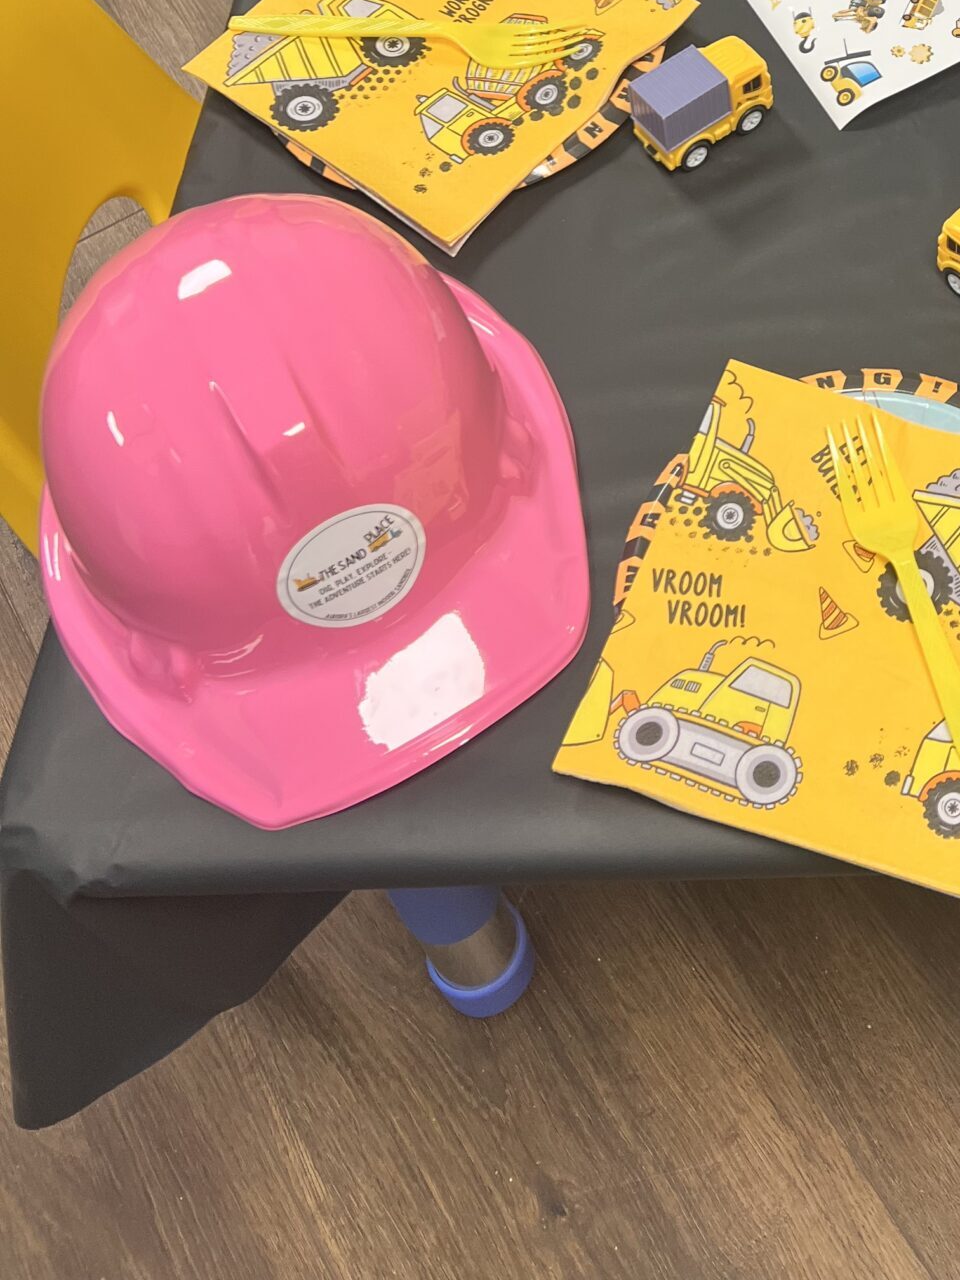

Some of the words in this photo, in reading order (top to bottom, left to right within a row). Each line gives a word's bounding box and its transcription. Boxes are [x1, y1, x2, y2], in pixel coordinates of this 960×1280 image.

[319, 565, 337, 581] THE
[338, 548, 367, 571] SAND
[363, 515, 394, 542] PLACE
[309, 599, 323, 610] THE
[325, 578, 365, 604] ADVENTURE
[367, 563, 391, 581] STARTS
[652, 568, 722, 597] VROOM
[668, 599, 746, 628] VROOM!
